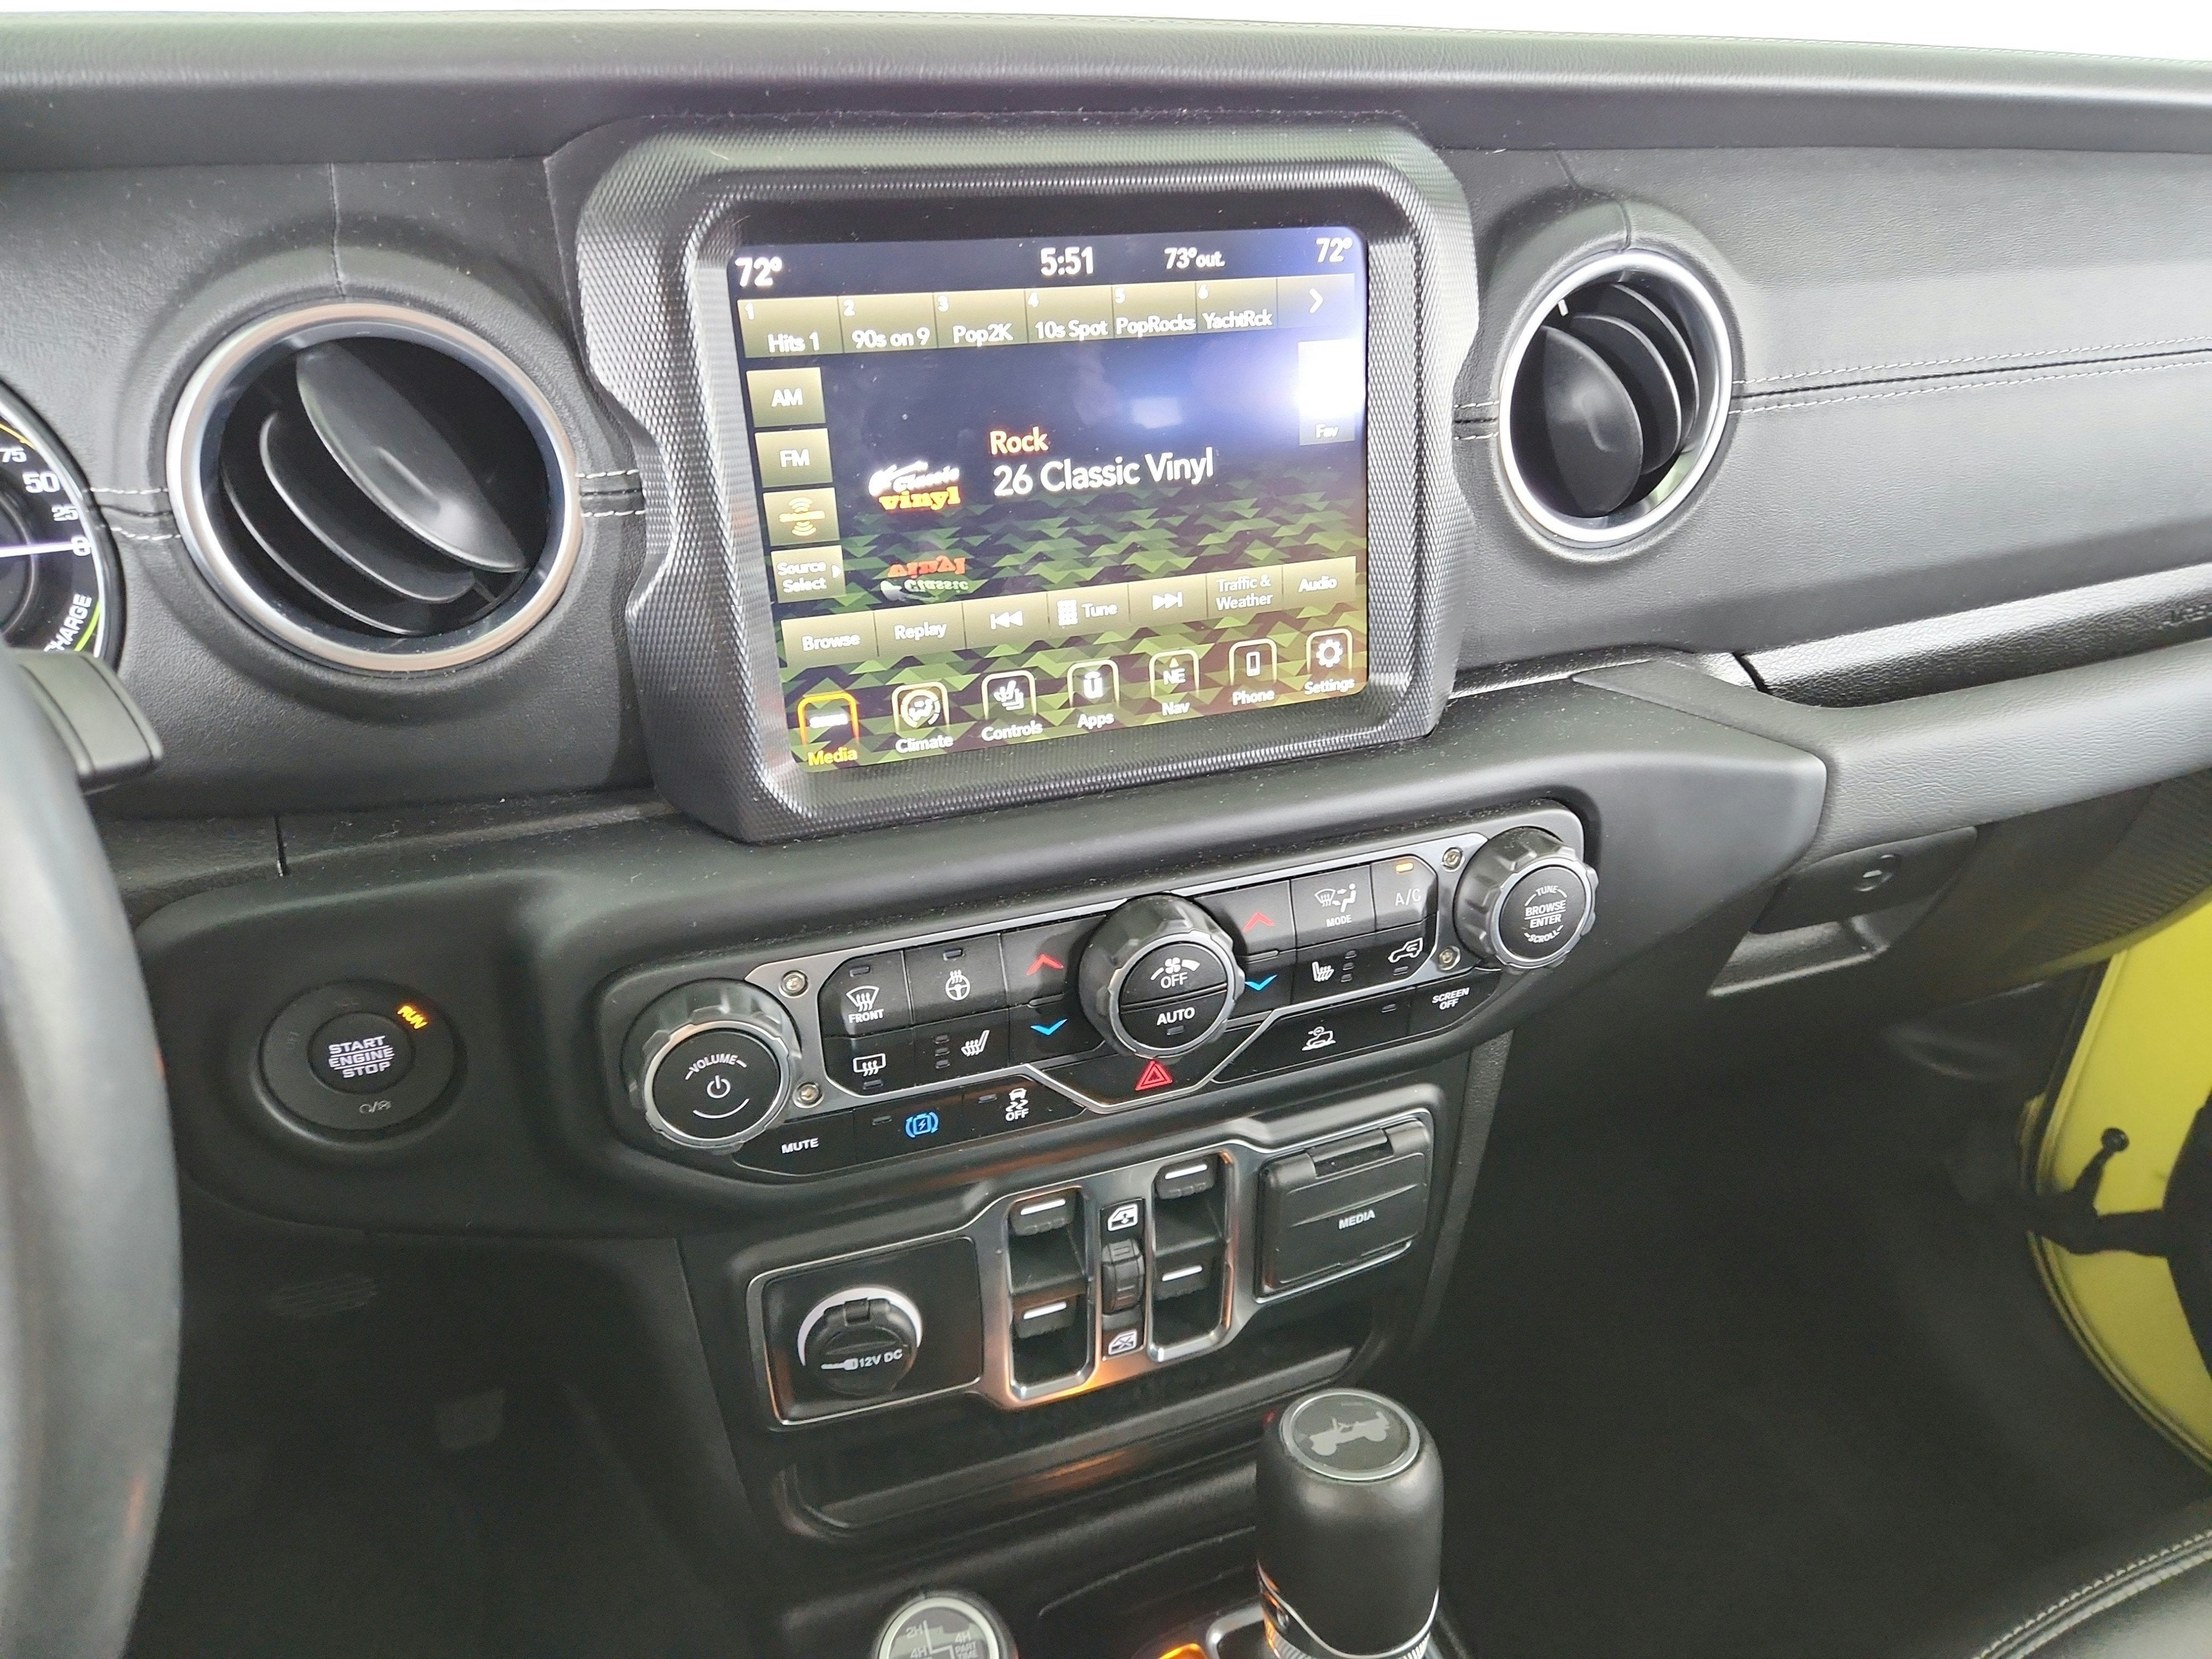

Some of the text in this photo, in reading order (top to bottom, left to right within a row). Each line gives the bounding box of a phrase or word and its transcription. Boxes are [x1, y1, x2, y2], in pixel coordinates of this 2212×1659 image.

[1040, 247, 1094, 275] 5:51
[1028, 292, 1040, 307] 4
[1115, 287, 1126, 303] 5
[1198, 284, 1209, 299] 6
[745, 303, 754, 320] 1
[844, 300, 855, 316] 2
[938, 296, 949, 312] 3
[1116, 313, 1196, 337] PopRocks
[1202, 309, 1273, 329] YachtRck
[852, 327, 930, 348] 90s on 9
[952, 322, 1014, 347] Pop2K
[1035, 320, 1109, 341] 10s Spot
[768, 331, 820, 353] Hits 1
[771, 387, 803, 407] AM
[1316, 424, 1339, 438] Fav
[990, 426, 1049, 455] Rock
[780, 449, 810, 467] FM
[994, 447, 1214, 496] 26 Classic Vinyl
[22, 472, 60, 494] 50
[879, 486, 961, 510] vinyl
[52, 505, 79, 521] 25
[71, 536, 91, 556] 0
[777, 561, 827, 576] Source
[783, 578, 827, 593] Select
[1216, 574, 1271, 592] Traffic &
[1299, 576, 1337, 592] Audio
[1081, 602, 1118, 618] Tune
[1216, 594, 1273, 611] Weather
[894, 622, 947, 641] Replay
[802, 634, 860, 651] Browse
[1163, 668, 1186, 685] NE
[1304, 678, 1356, 695] Settings
[1232, 690, 1275, 706] Phone
[1162, 701, 1190, 716] Nav
[1077, 713, 1114, 730] Apps
[981, 720, 1043, 742] Controls
[895, 735, 953, 754] Climate
[808, 747, 858, 766] Media
[1395, 888, 1421, 906] A/C
[1536, 885, 1559, 896] TUNE
[1525, 900, 1566, 917] BROWSE
[1326, 915, 1352, 928] MODE
[1530, 913, 1562, 929] ENTER
[1528, 930, 1560, 943] SCROLL
[1160, 972, 1188, 989] OFF
[1432, 988, 1470, 1005] SCREEN
[1439, 997, 1459, 1010] OFF
[397, 1006, 428, 1029] RUN
[848, 1008, 884, 1023] FRONT
[1156, 1007, 1195, 1026] AUTO
[329, 1035, 386, 1054] START
[329, 1047, 395, 1068] ENGINE
[690, 1053, 738, 1073] VOLUME
[342, 1061, 391, 1078] STOP
[1005, 1109, 1029, 1122] OFF
[781, 1138, 819, 1154] MUTE
[1338, 1209, 1376, 1230] MEDIA
[859, 1348, 903, 1368] 12V DC
[905, 1624, 923, 1639] 2H
[955, 1630, 972, 1643] 4H
[910, 1646, 928, 1659] 4H
